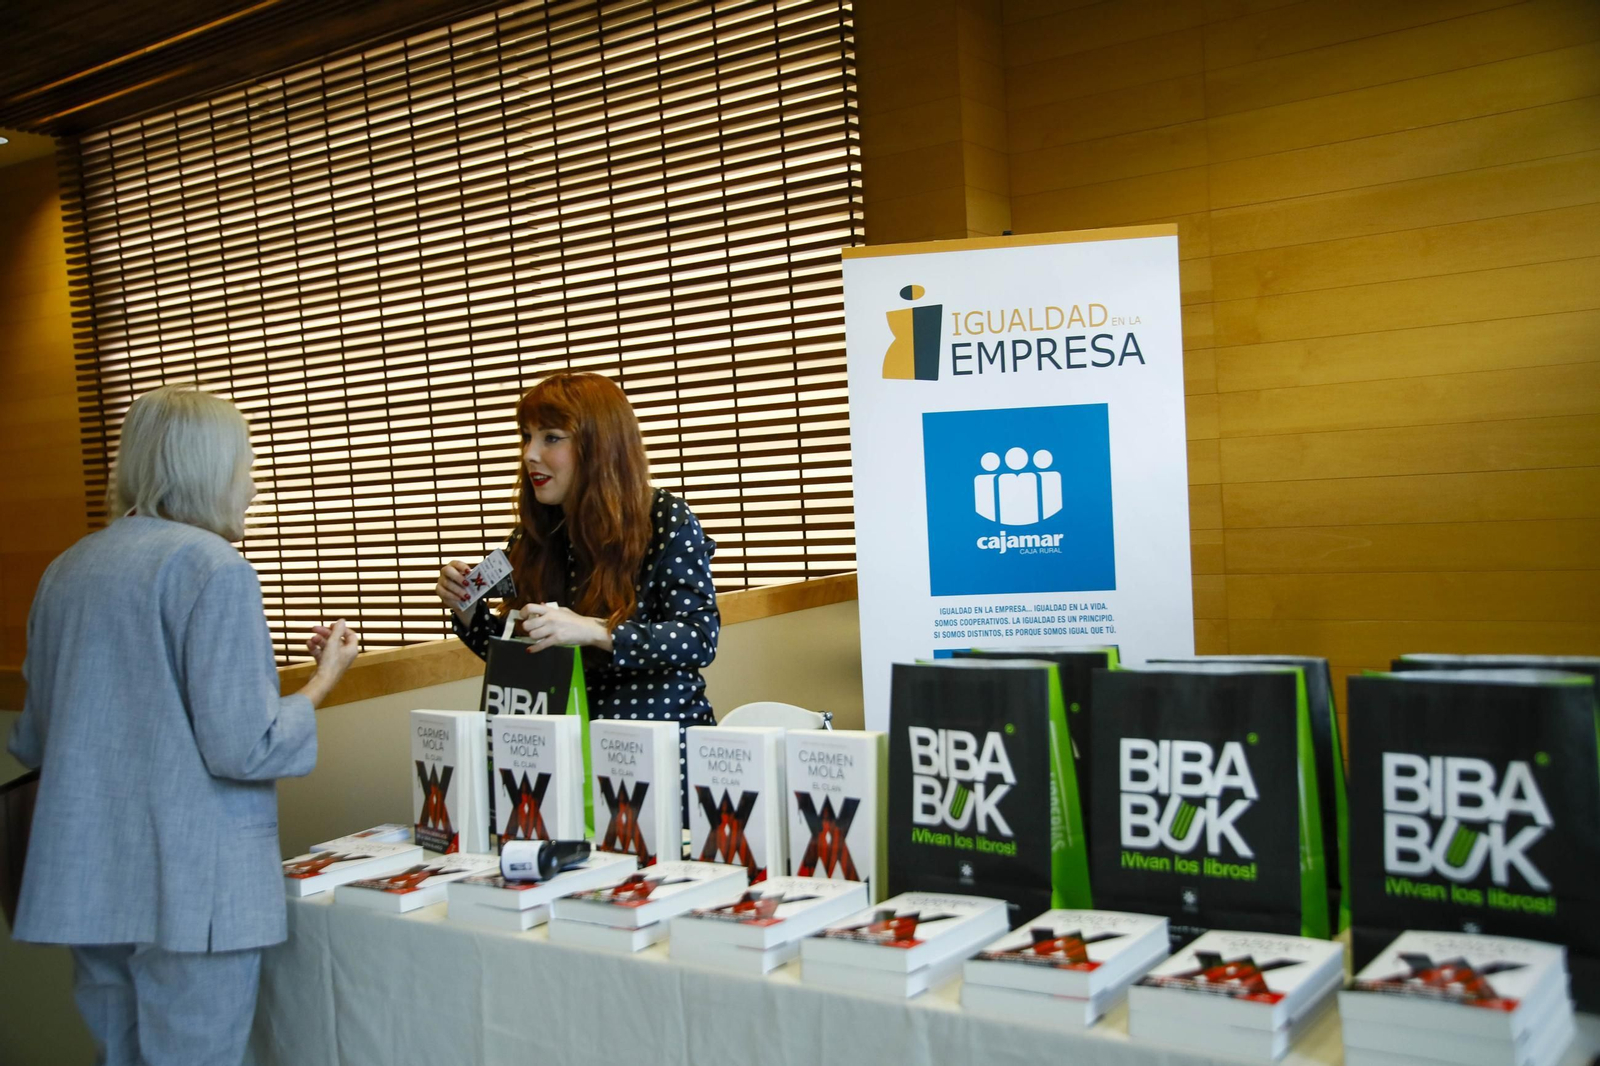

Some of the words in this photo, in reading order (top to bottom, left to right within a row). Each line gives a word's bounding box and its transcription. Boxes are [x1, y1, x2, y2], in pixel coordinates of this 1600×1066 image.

[952, 303, 1108, 336] IGUALDAD
[1111, 316, 1125, 326] EN
[1129, 315, 1142, 325] LA
[952, 332, 1146, 376] EMPRESA
[976, 530, 1064, 554] cajamar
[939, 607, 973, 615] IGUALDAD
[974, 606, 983, 614] EN
[984, 605, 994, 614] LA
[995, 604, 1033, 613] EMPRESA...
[1034, 603, 1068, 612] IGUALDAD
[1069, 603, 1079, 611] EN
[1080, 602, 1089, 611] LA
[1090, 602, 1109, 610] VIDA.
[934, 619, 958, 627] SOMOS
[959, 617, 1011, 626] COOPERATIVOS.
[1012, 616, 1021, 625] LA
[1022, 615, 1056, 624] IGUALDAD
[1057, 615, 1066, 623] ES
[1067, 614, 1077, 623] UN
[1079, 613, 1115, 622] PRINCIPIO.
[933, 631, 940, 639] SI
[942, 630, 966, 639] SOMOS
[967, 629, 1004, 638] DISTINTOS,
[1005, 628, 1014, 637] ES
[1015, 628, 1042, 637] PORQUE
[1043, 627, 1067, 636] SOMOS
[1069, 626, 1089, 635] IGUAL
[1090, 626, 1104, 635] QUE
[1105, 624, 1116, 634] TÚ.
[486, 684, 548, 716] BIBA
[417, 726, 449, 741] CARMEN
[502, 732, 546, 747] CARMEN
[422, 738, 444, 751] MOLA
[510, 745, 539, 758] MOLA
[600, 738, 644, 754] CARMEN
[699, 745, 752, 762] CARMEN
[908, 726, 1017, 784] BIBA
[608, 752, 637, 766] MOLA
[708, 759, 744, 775] MOLA
[798, 749, 854, 767] CARMEN
[1119, 738, 1258, 799] BIBA
[808, 765, 845, 780] MOLA
[1382, 752, 1555, 829] BIBA
[913, 774, 1014, 837] BUK
[1120, 792, 1254, 859] BUK
[954, 832, 974, 850] los
[976, 835, 1017, 856] libros!
[1383, 812, 1552, 892] BUK
[1174, 854, 1199, 874] los
[1203, 857, 1257, 881] libros!
[1451, 882, 1483, 905] los
[1487, 887, 1557, 915] libros!
